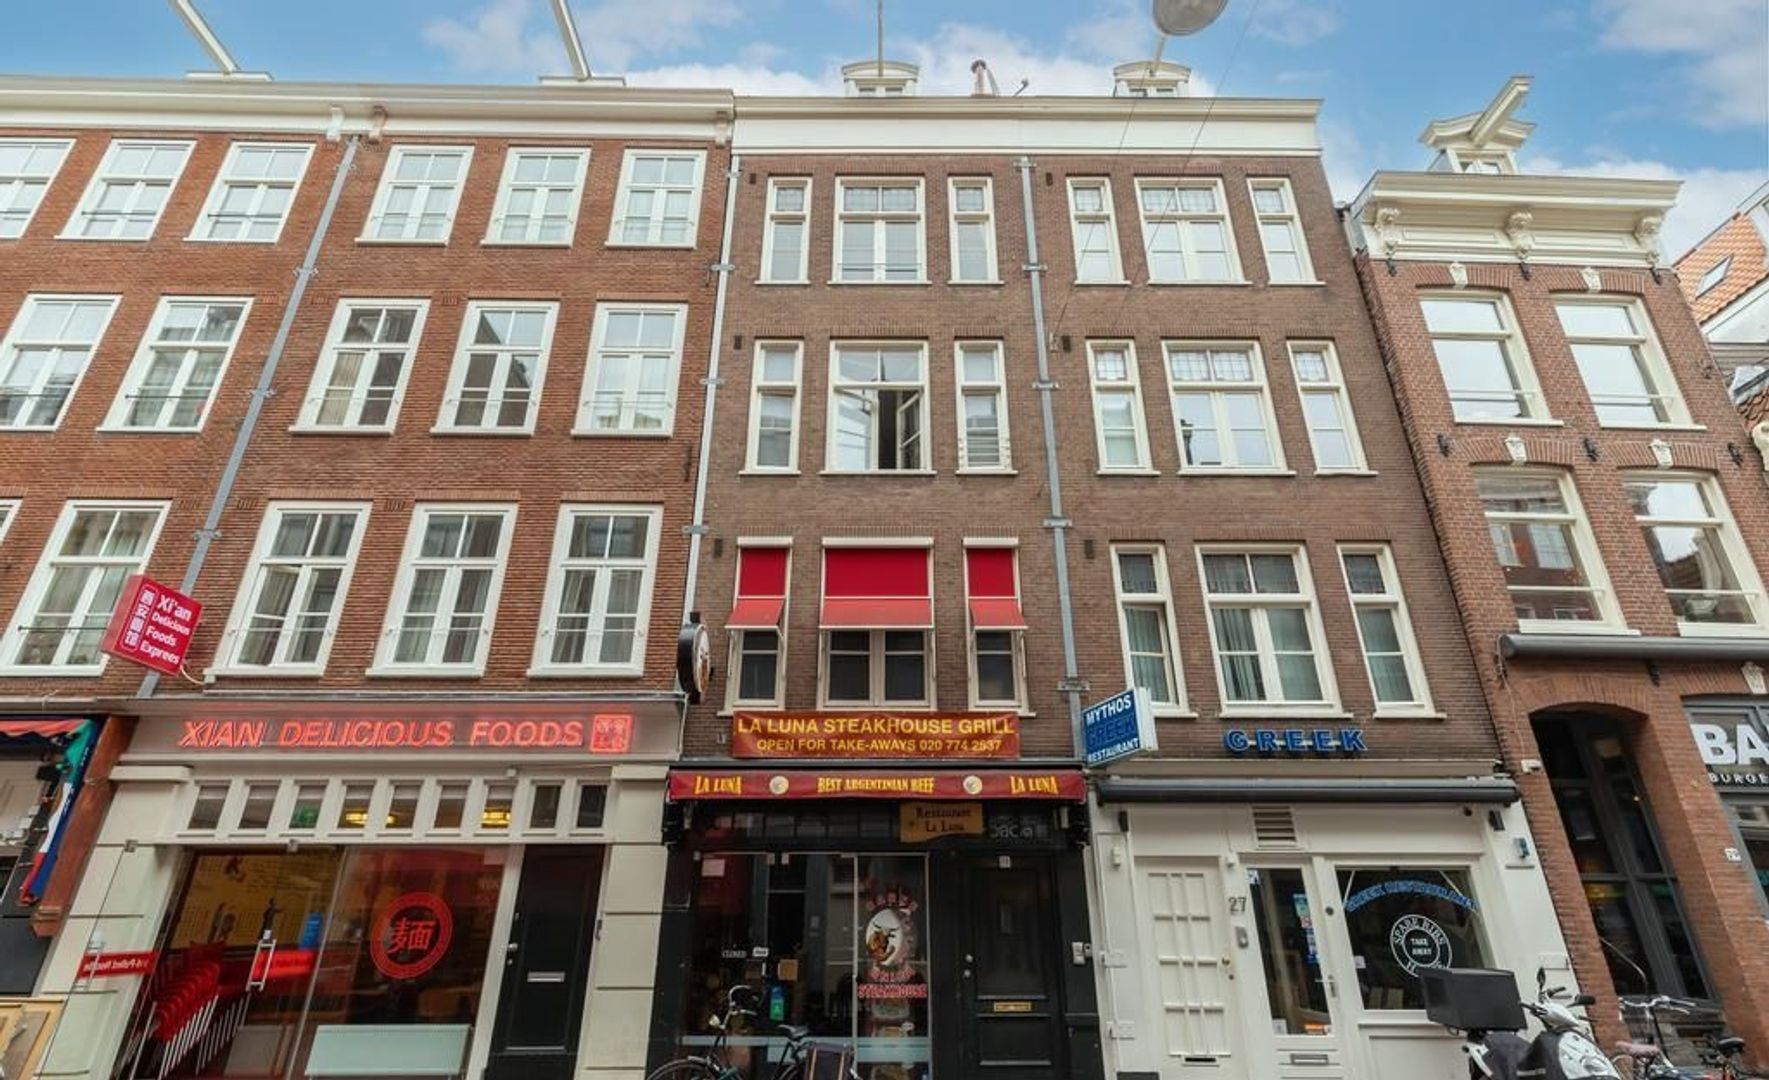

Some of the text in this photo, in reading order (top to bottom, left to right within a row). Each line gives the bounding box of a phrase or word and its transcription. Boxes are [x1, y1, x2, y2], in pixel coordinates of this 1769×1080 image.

[157, 594, 192, 622] Xi'an
[152, 611, 190, 636] Delicious
[146, 625, 177, 647] Foods
[1086, 694, 1132, 726] MYTHOS
[178, 719, 267, 748] XIAN
[278, 719, 455, 748] DELICIOUS
[470, 719, 584, 747] FOODS
[737, 718, 1015, 734] LA LUNA STEAKHOUSE GRILL
[756, 739, 795, 752] OPEN
[798, 739, 826, 751] FOR
[830, 739, 916, 752] TAKE-AWAYS
[920, 739, 943, 751] 020
[946, 739, 968, 751] 774
[1225, 727, 1368, 752] GREEK
[1690, 724, 1769, 765] BA
[694, 775, 742, 795] LA LUNA
[817, 777, 842, 793] BEST
[1010, 775, 1059, 794] LA LUNA
[1228, 896, 1247, 912] 27
[1393, 917, 1420, 944] SPARE
[1410, 938, 1429, 946] TAKE
